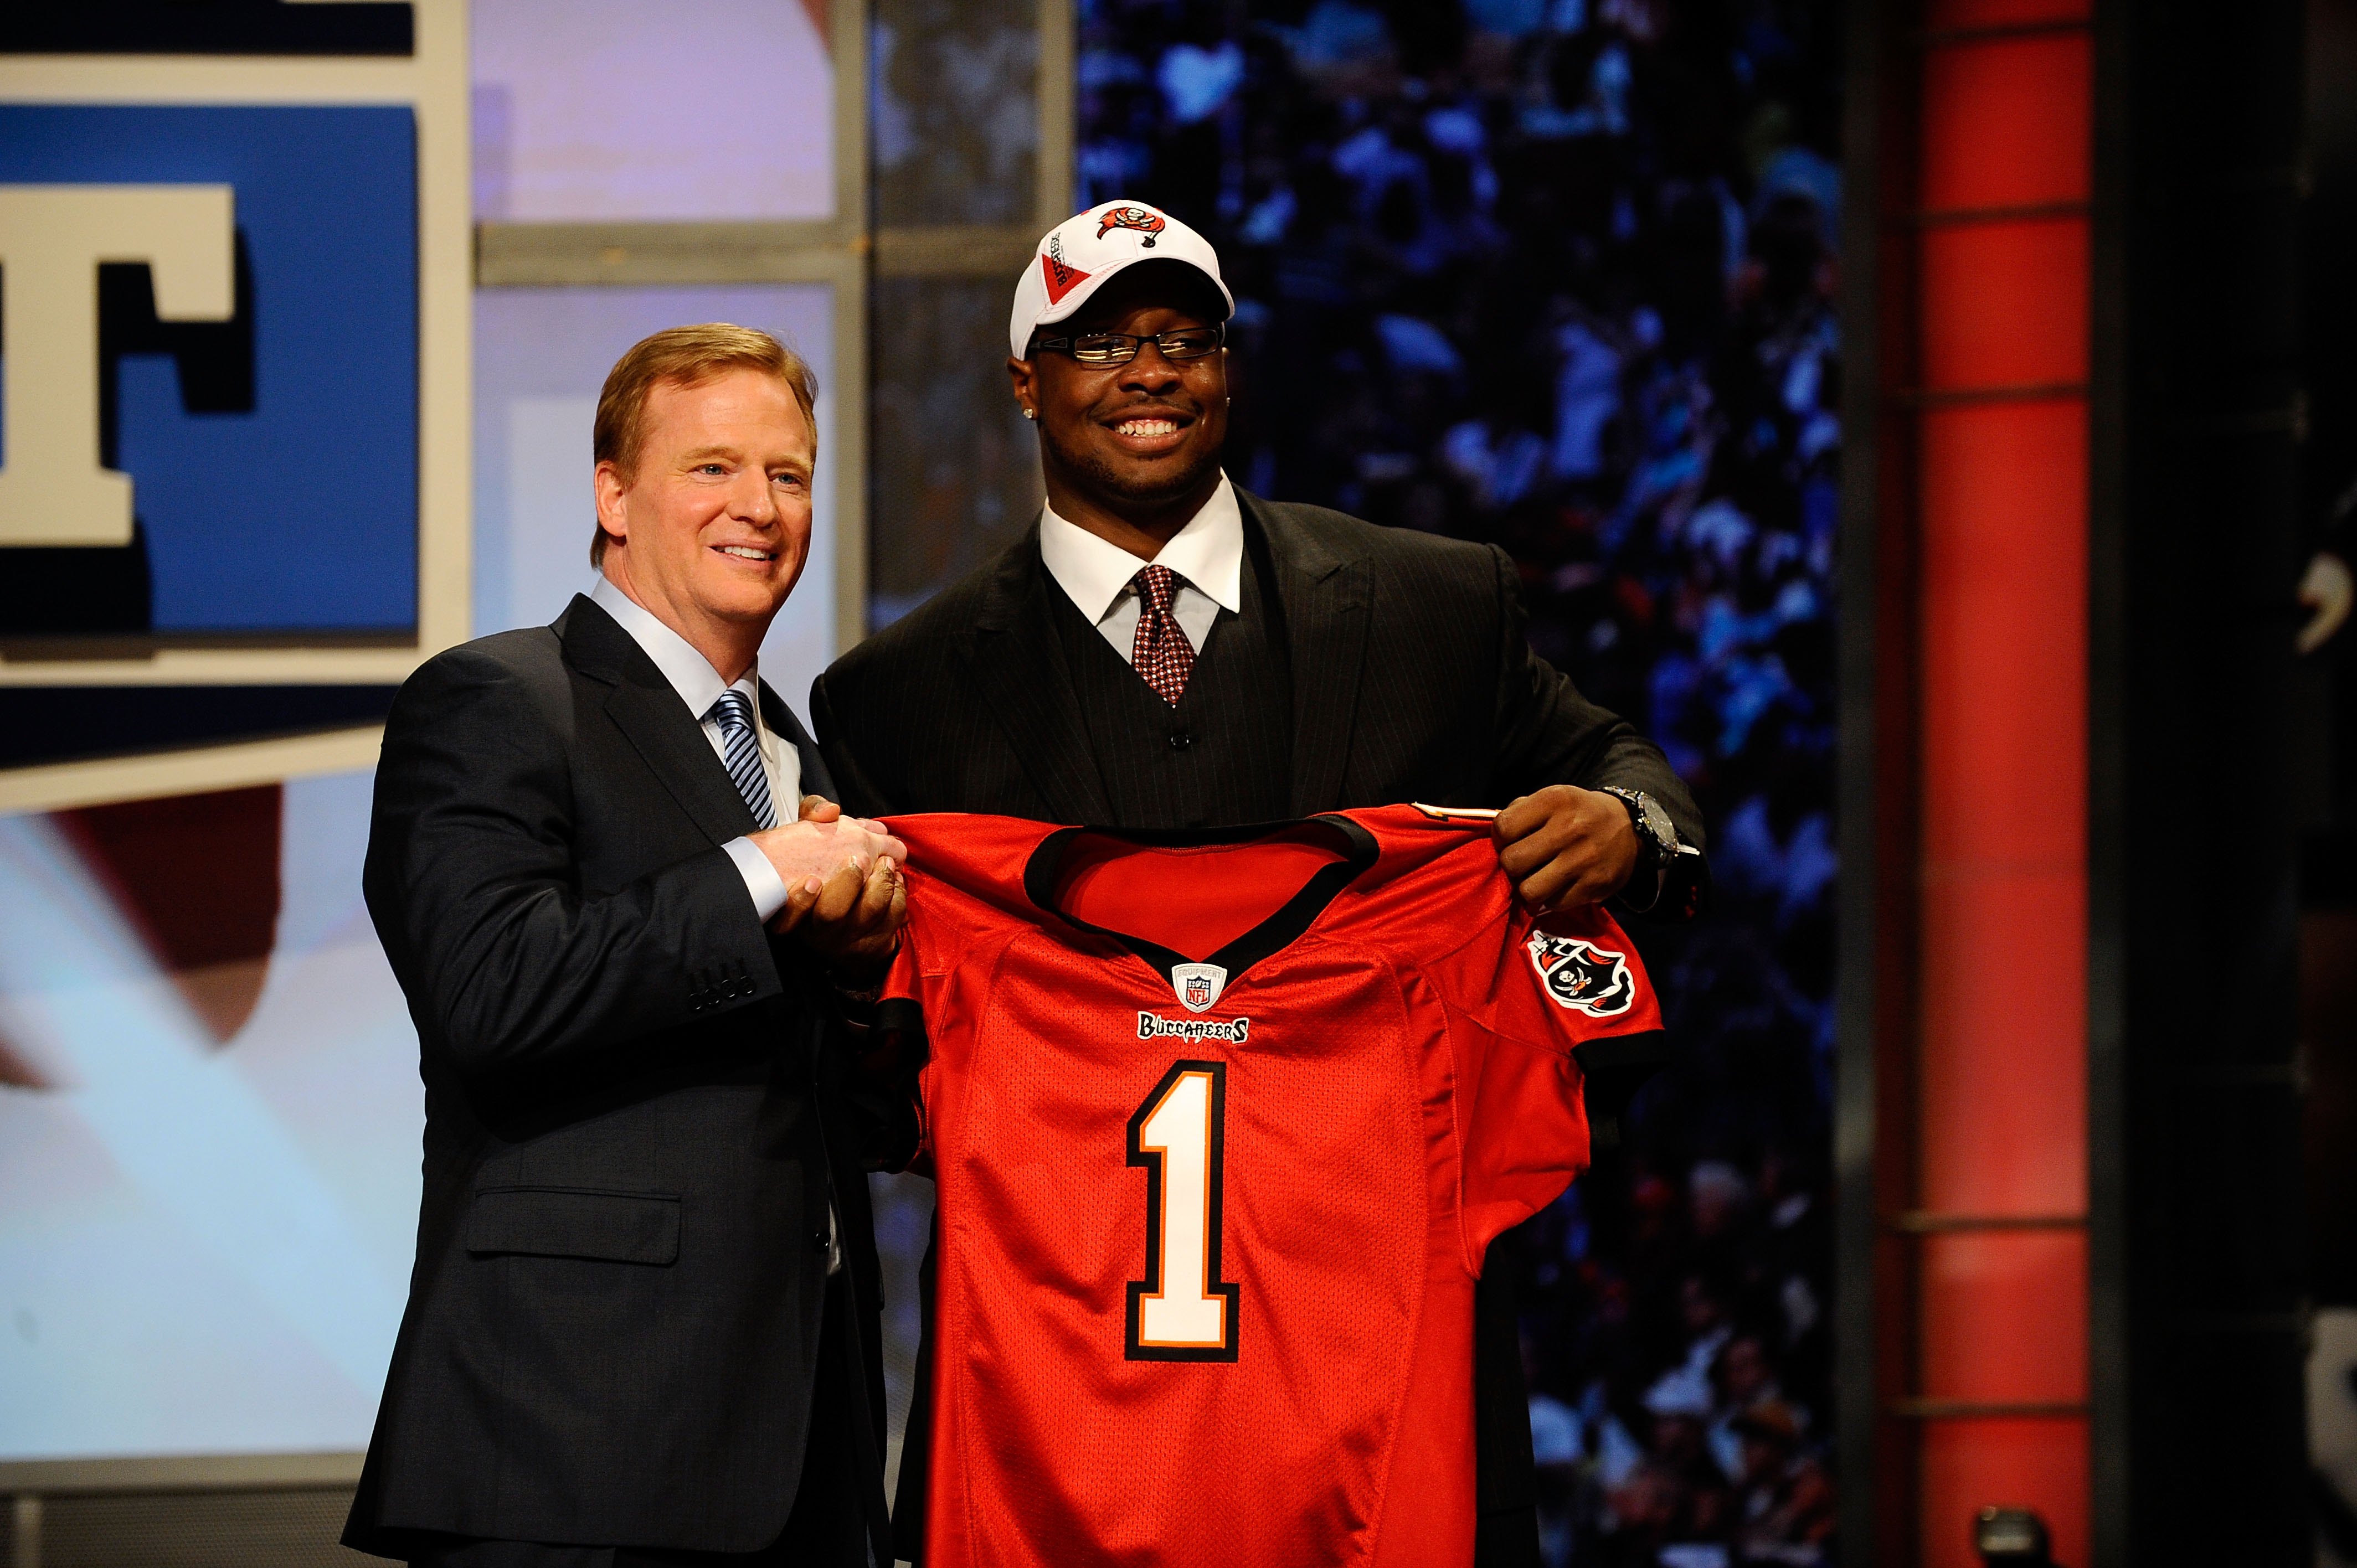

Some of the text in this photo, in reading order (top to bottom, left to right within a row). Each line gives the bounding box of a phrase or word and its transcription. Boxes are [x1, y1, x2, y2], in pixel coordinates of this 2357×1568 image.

[1177, 968, 1222, 979] EQUIPMENT
[1188, 989, 1208, 1003] NFL
[1125, 1059, 1240, 1362] 1
